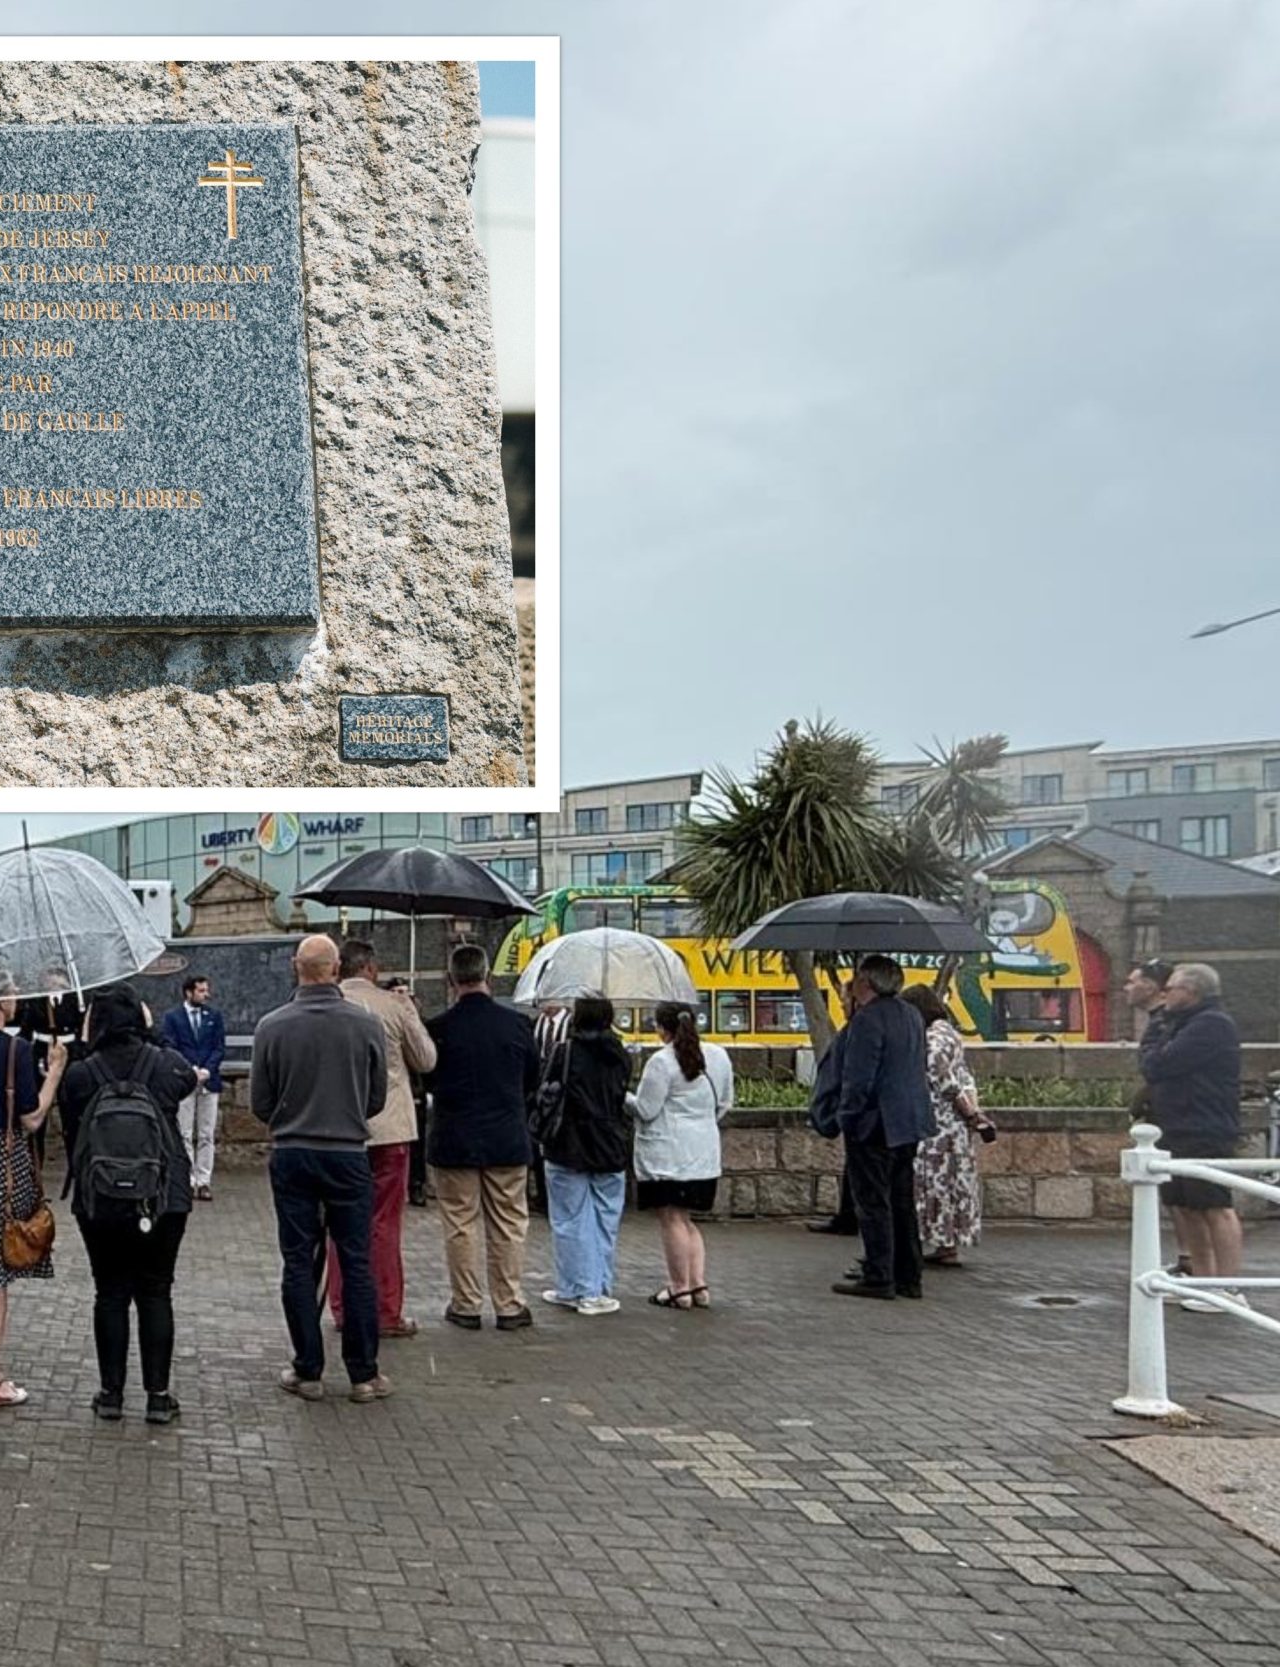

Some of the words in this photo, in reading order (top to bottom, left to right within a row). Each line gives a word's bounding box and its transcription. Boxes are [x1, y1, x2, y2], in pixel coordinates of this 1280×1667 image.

[28, 230, 111, 249] JERSEY
[133, 264, 273, 284] REJOIGNANT
[3, 302, 123, 322] REPONDRE
[129, 302, 145, 322] A
[150, 302, 237, 322] L'APPEL
[32, 338, 74, 359] 1940
[10, 373, 53, 394] PAR
[3, 411, 32, 432] DE
[38, 411, 126, 432] GAULLE
[121, 488, 204, 509] LIBRES
[348, 730, 443, 745] MEMORIALS
[303, 817, 365, 836] WHARF
